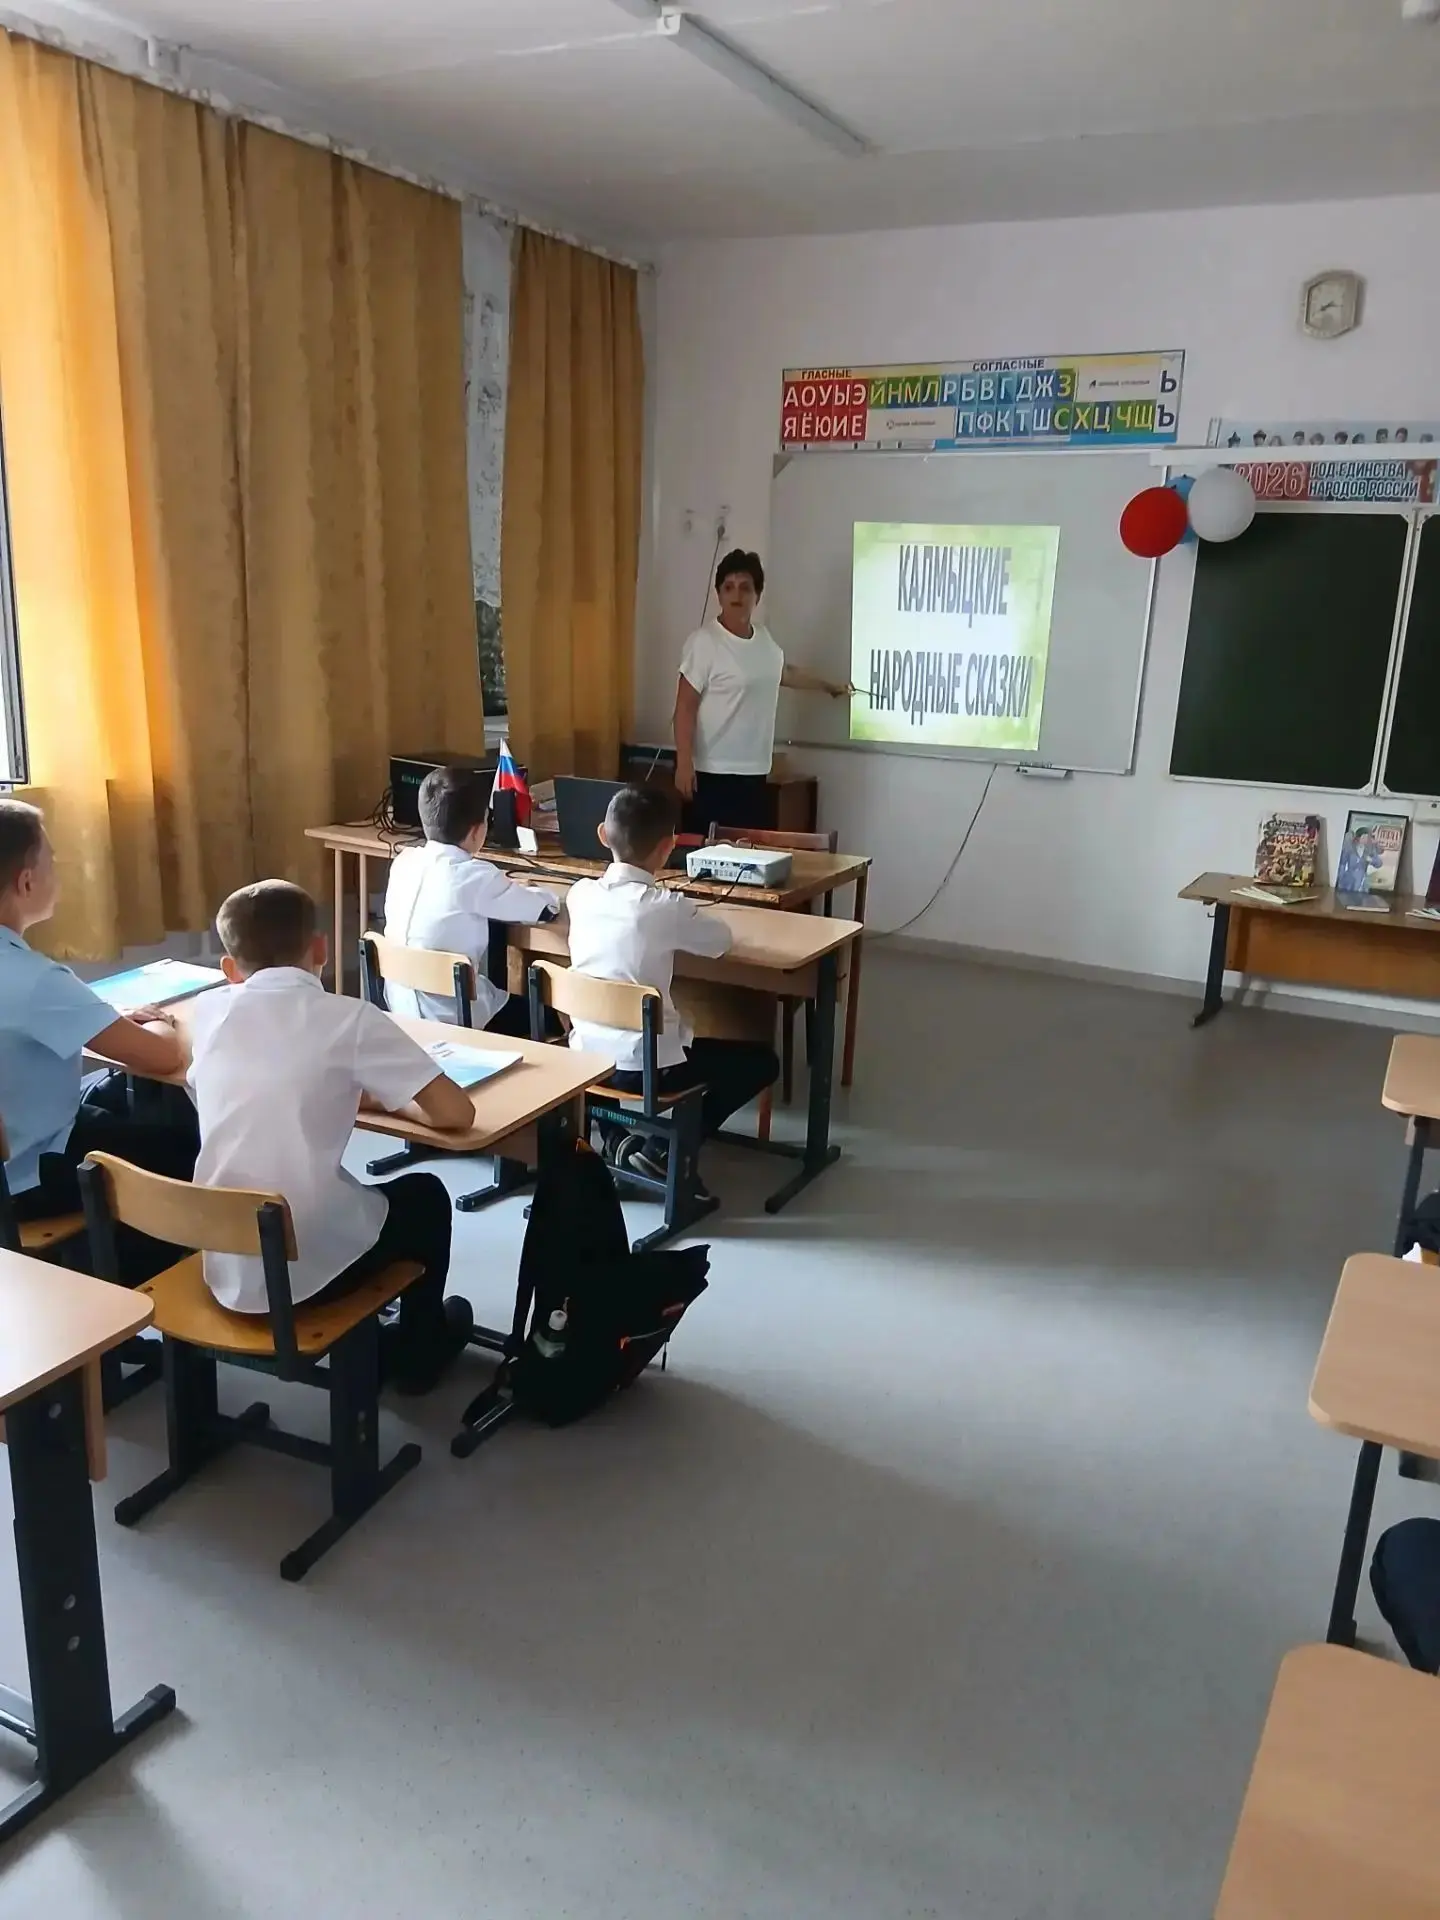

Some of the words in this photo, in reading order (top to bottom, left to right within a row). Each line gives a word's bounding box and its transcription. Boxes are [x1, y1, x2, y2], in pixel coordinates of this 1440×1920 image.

[801, 369, 853, 380] ГЛАСНЫЕ
[972, 359, 1045, 372] СОГЛАСНЫЕ
[1310, 461, 1336, 478] ГОД
[1339, 460, 1405, 478] ЕДИНСТВА
[1308, 480, 1367, 498] НАРОДОВ
[1367, 479, 1420, 497] РОССИИ
[898, 544, 1012, 628] КАЛМЫЦКИЕ
[869, 649, 963, 725] НАРОДНЫЕ
[965, 652, 1034, 718] СКАЗКИ
